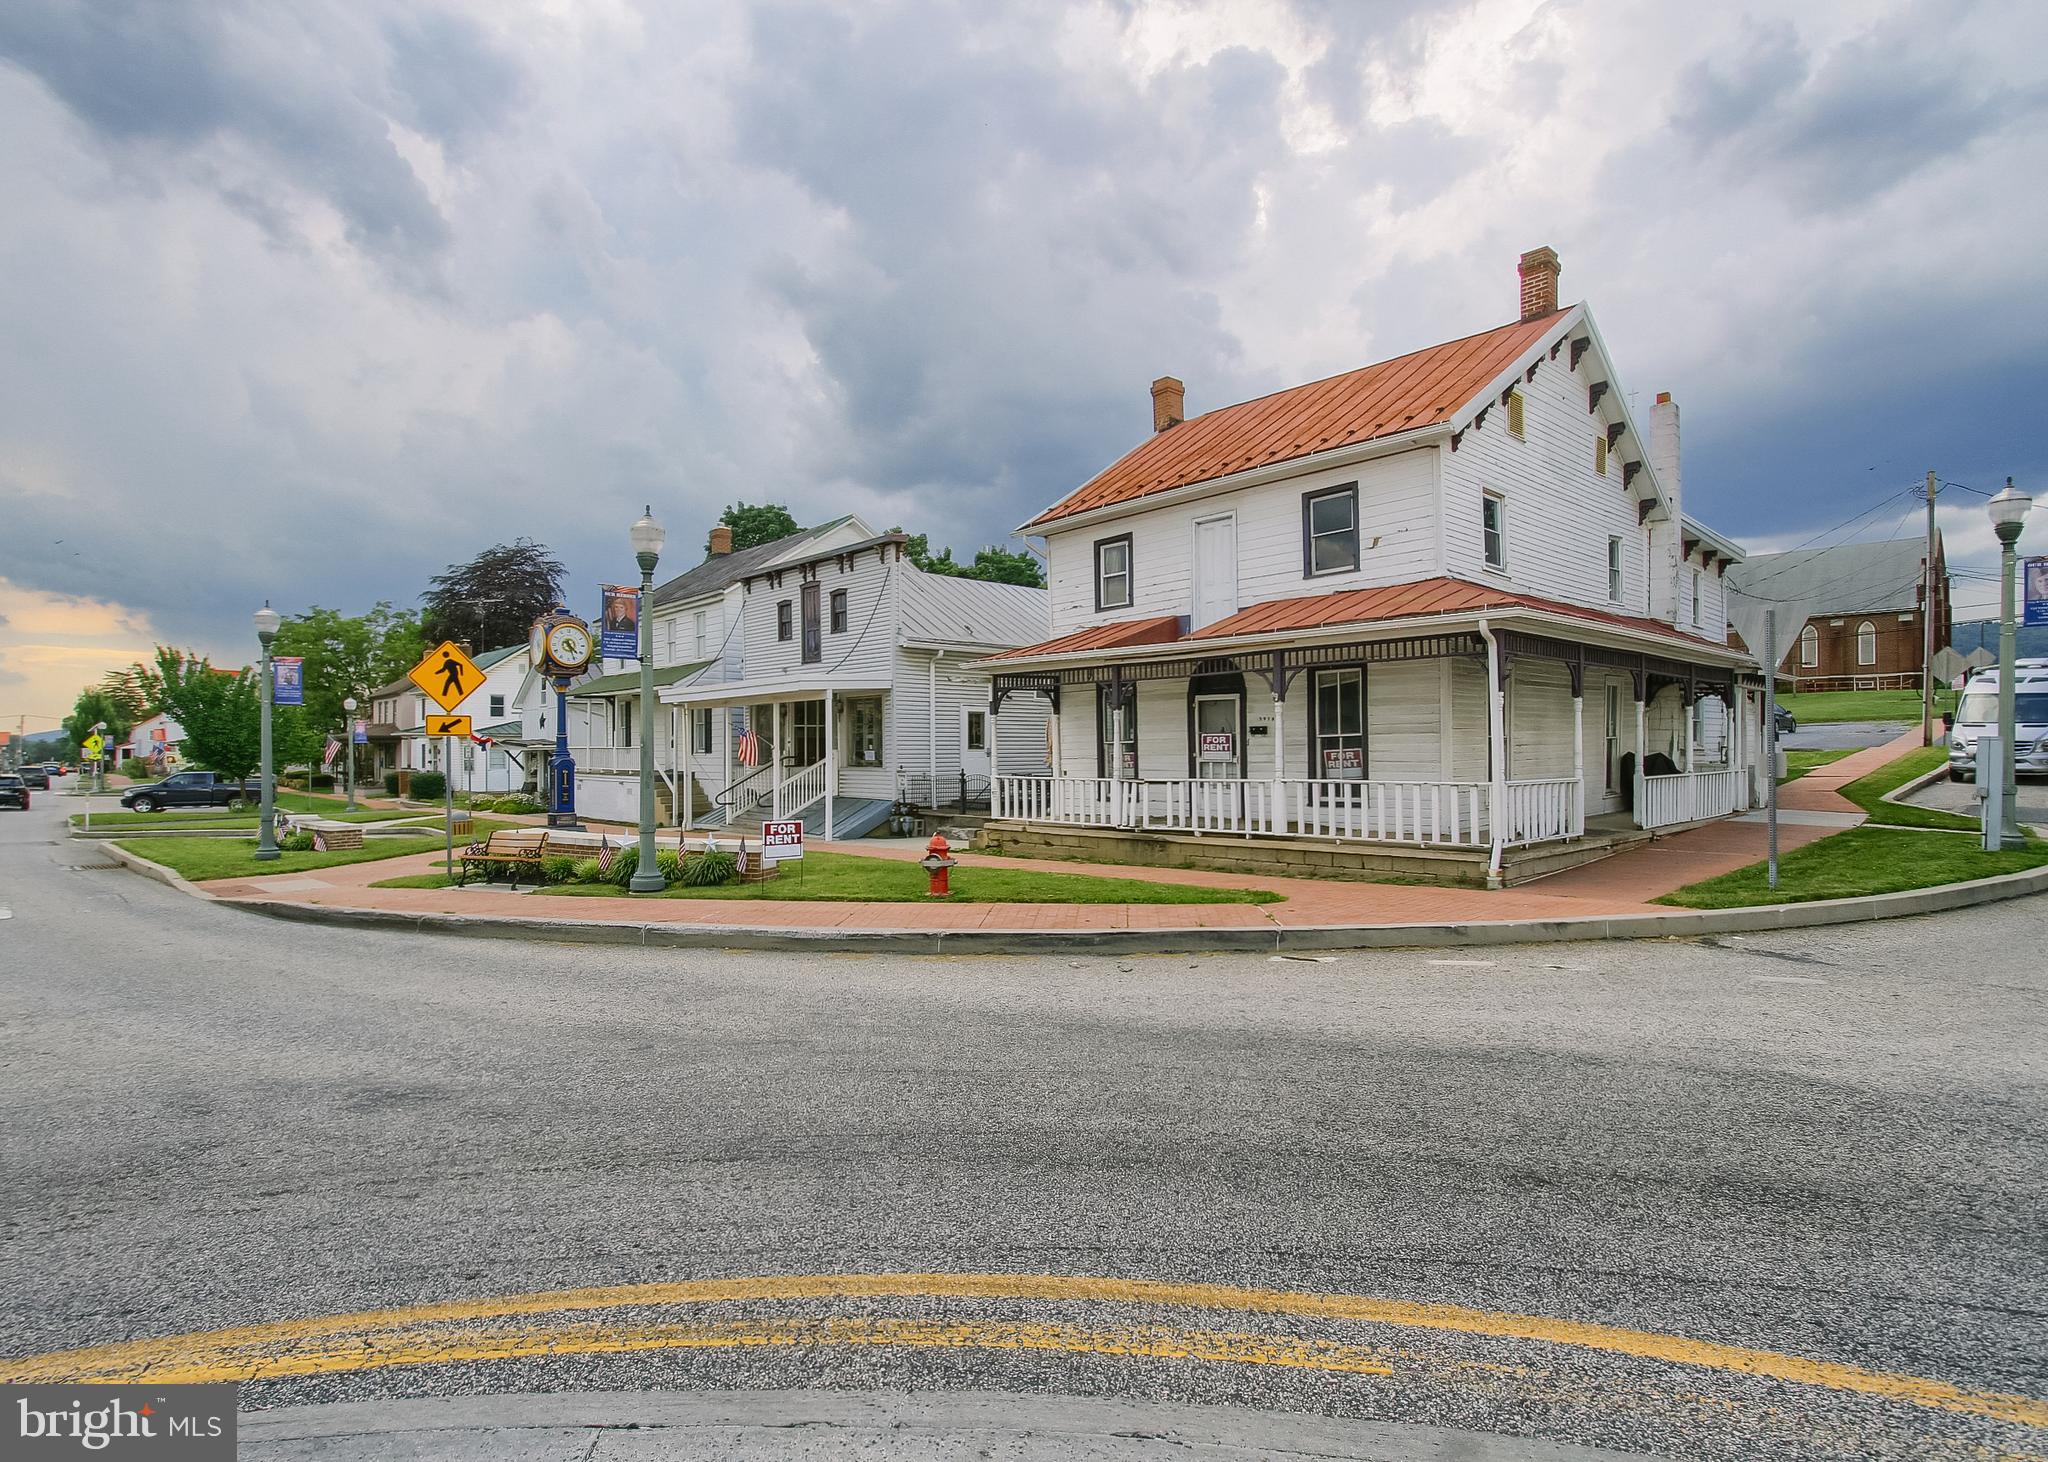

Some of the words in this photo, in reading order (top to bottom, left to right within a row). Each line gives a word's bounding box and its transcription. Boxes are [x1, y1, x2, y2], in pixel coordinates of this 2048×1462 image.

[1206, 736, 1226, 744] FOR
[1330, 751, 1355, 760] FOR
[1328, 760, 1360, 768] RENT
[770, 824, 796, 834] FOR
[766, 834, 800, 845] RENT
